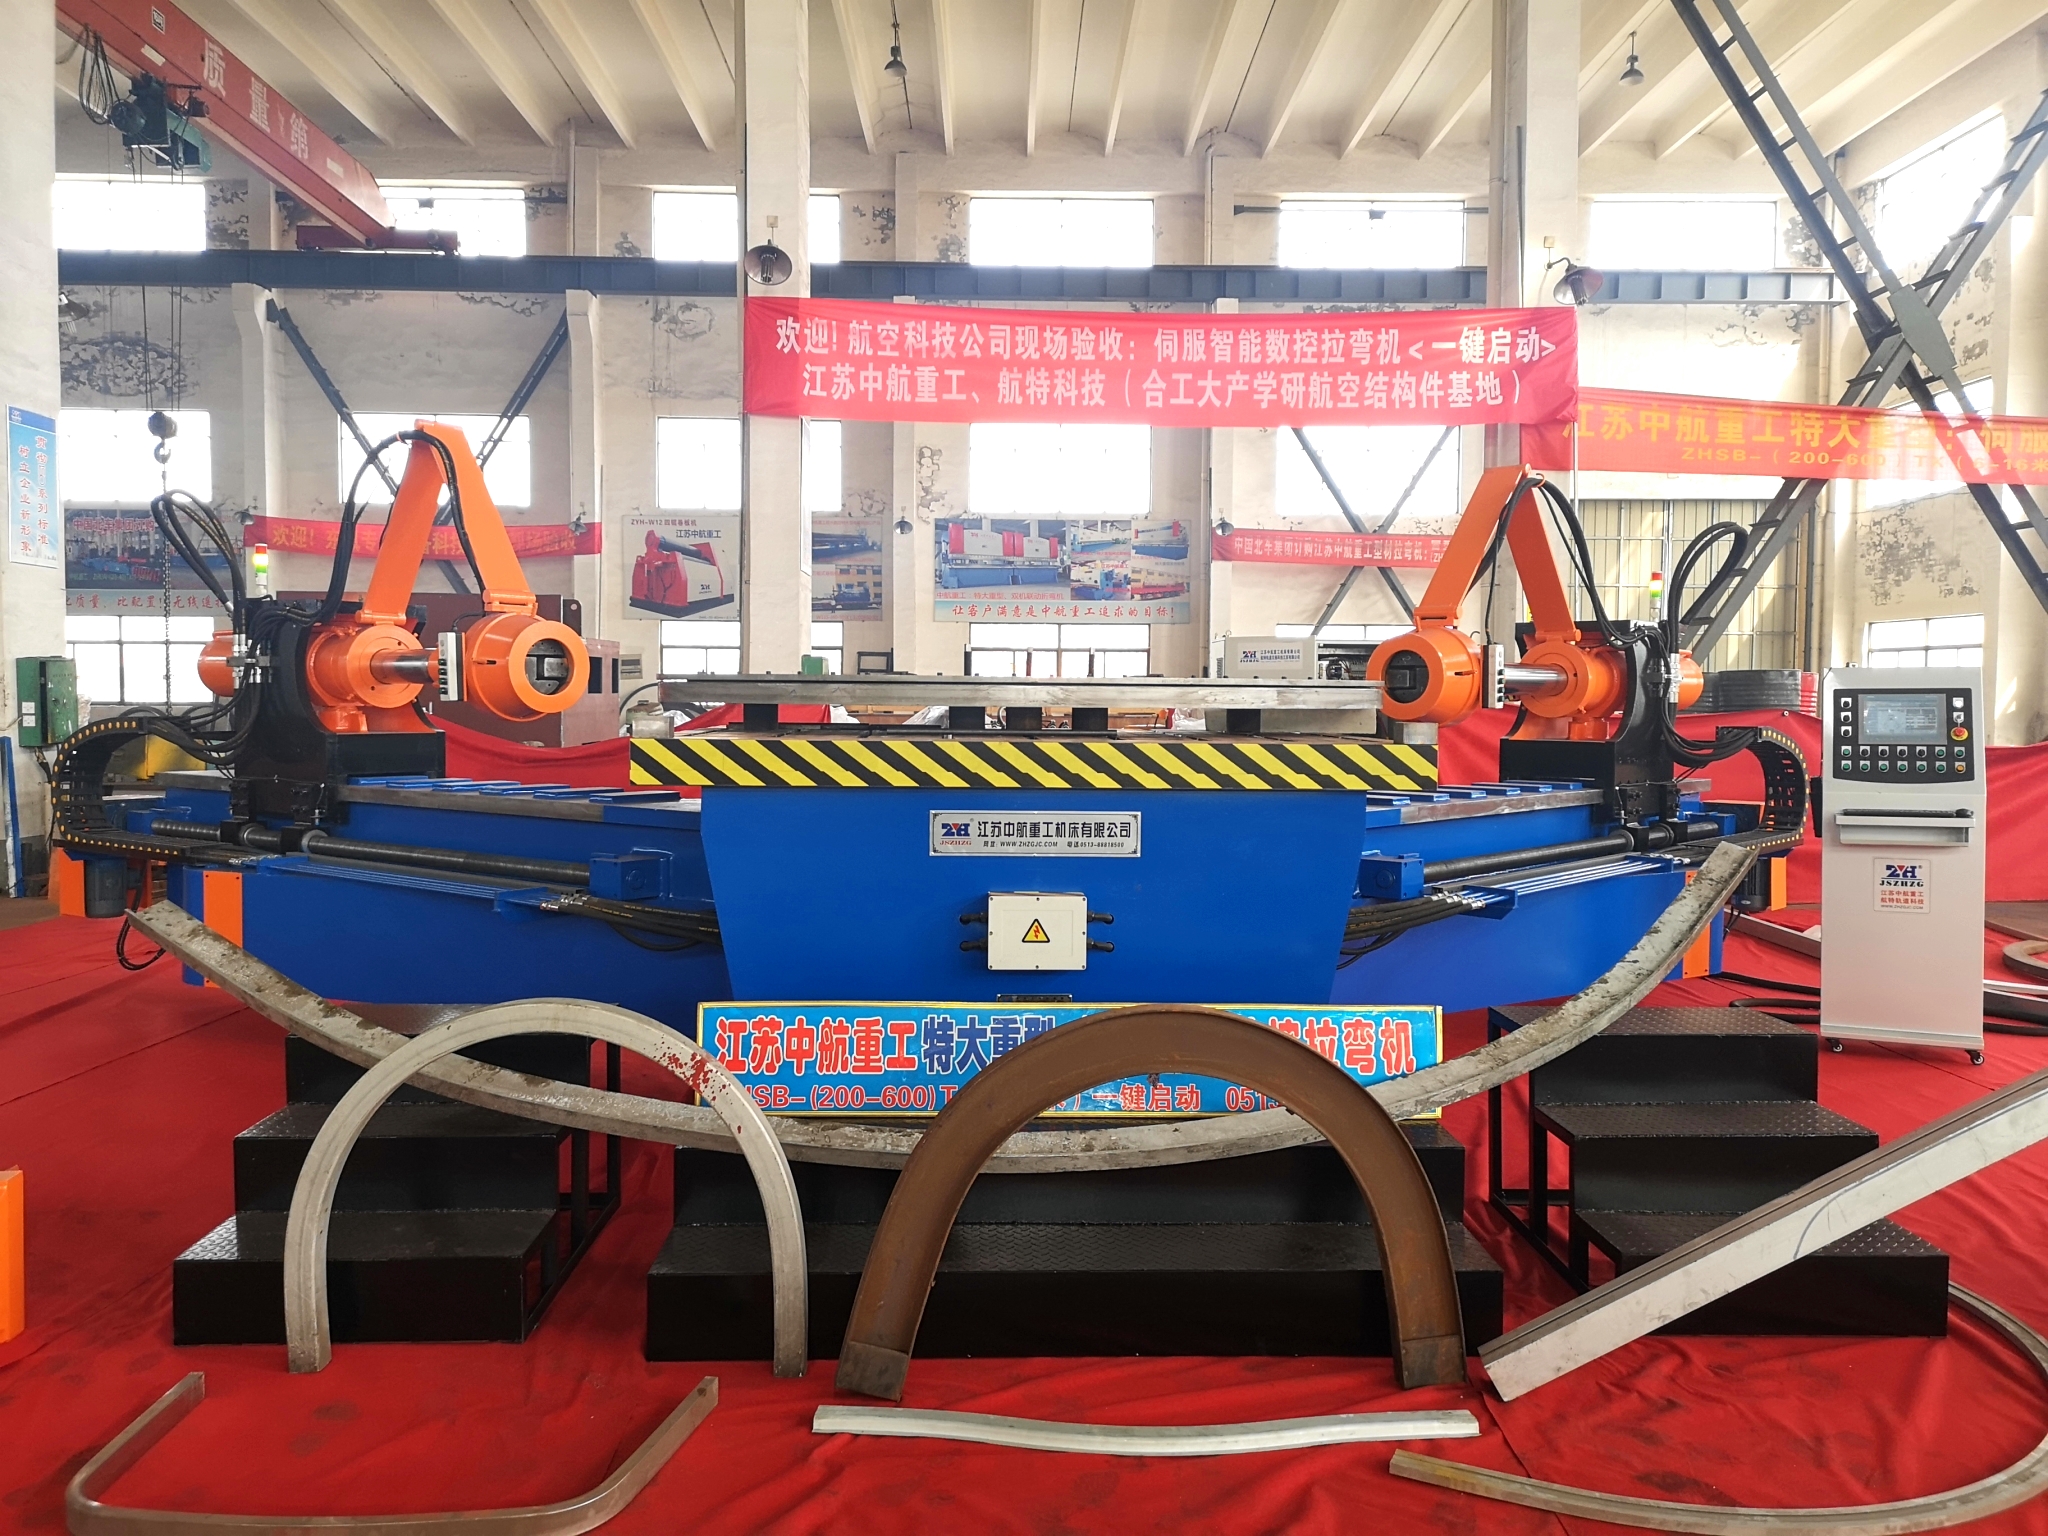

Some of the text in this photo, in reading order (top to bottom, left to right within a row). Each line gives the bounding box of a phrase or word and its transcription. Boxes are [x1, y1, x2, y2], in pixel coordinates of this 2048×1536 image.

[18, 445, 31, 552] 树立企业新形象
[675, 529, 722, 539] 江苏中航重工
[952, 604, 1174, 619] 让客户满意是中航重工追求的目标!
[977, 821, 1131, 839] 江苏中航重工机床有限公司
